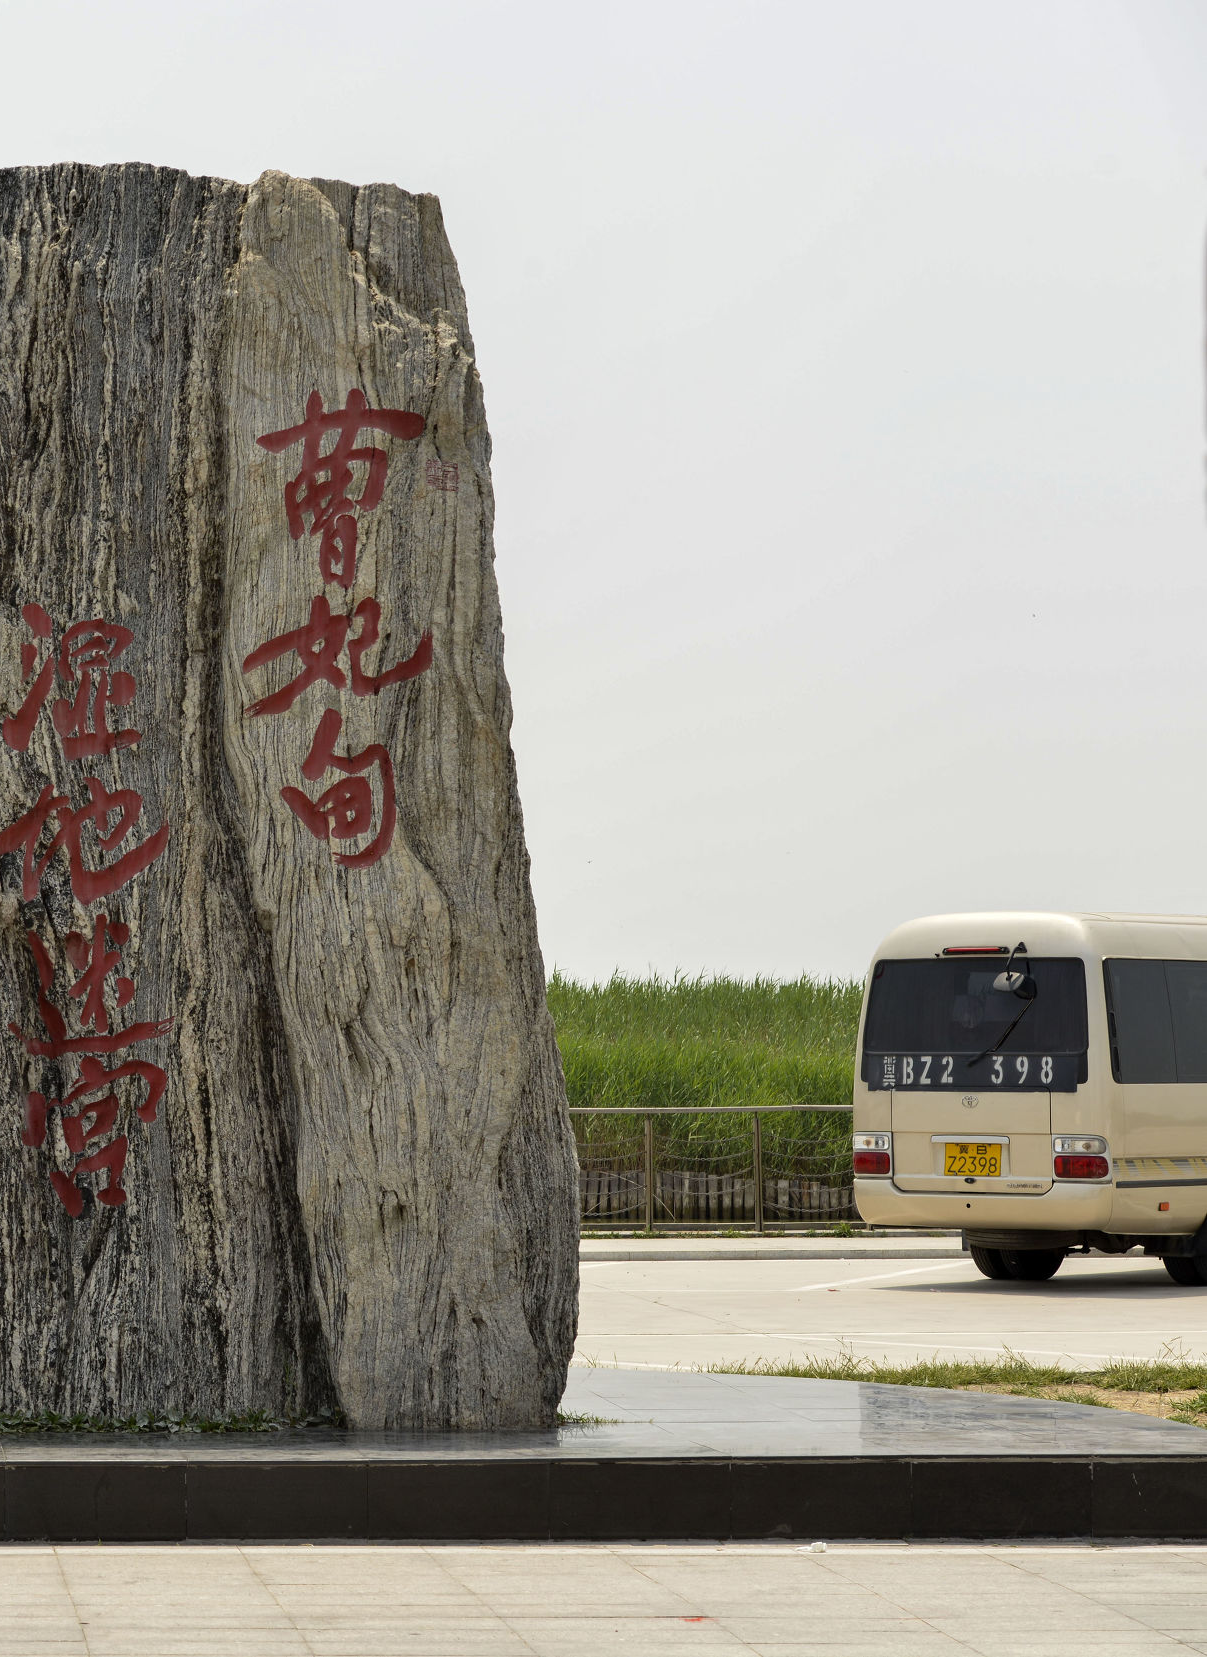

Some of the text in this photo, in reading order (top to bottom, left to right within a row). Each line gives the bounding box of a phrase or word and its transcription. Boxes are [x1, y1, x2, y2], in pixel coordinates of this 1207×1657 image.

[243, 388, 434, 870] 曹妃甸
[947, 1156, 998, 1174] Z2398
